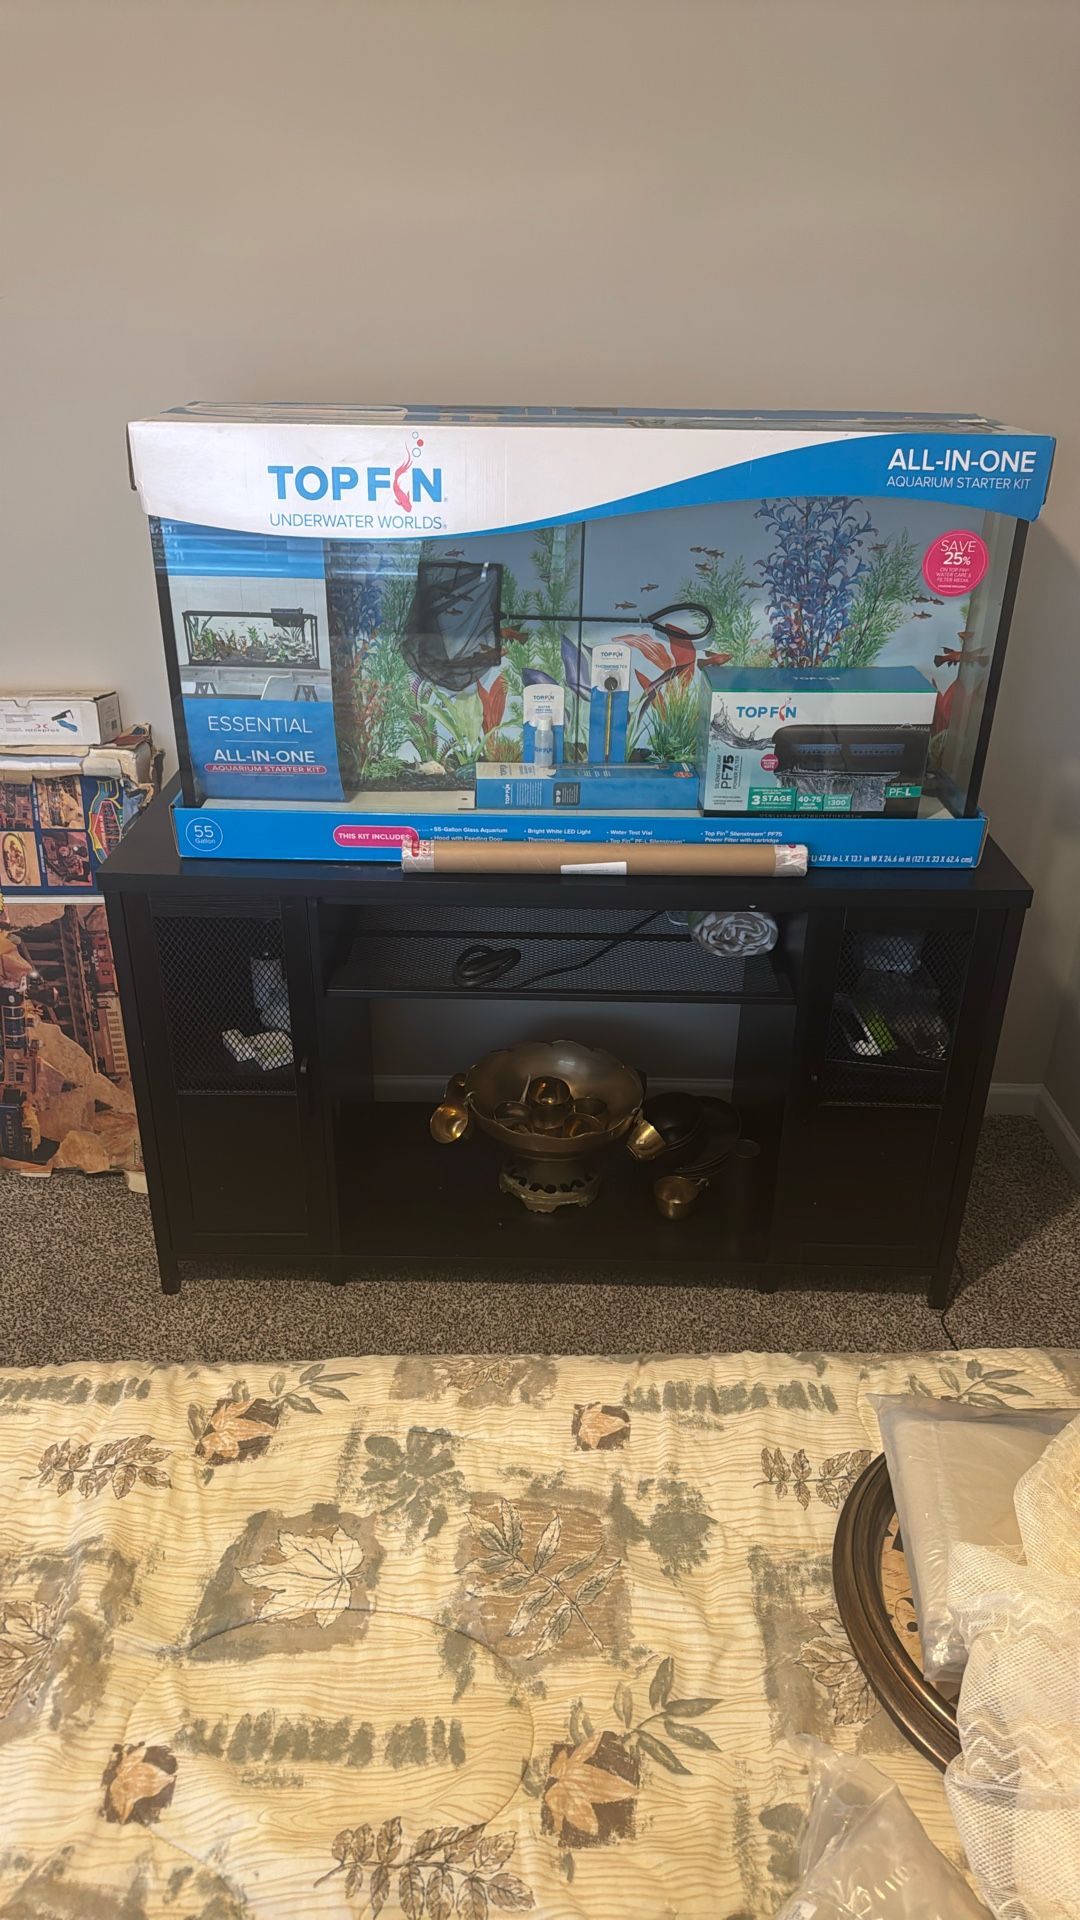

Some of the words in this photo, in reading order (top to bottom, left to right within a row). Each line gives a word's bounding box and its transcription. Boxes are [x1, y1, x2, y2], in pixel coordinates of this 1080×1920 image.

[887, 448, 1037, 473] ALL-IN-ONE
[267, 465, 359, 501] TOP
[886, 475, 953, 488] AQUARIUM
[956, 477, 1010, 489] STARTER
[1013, 478, 1032, 490] KIT
[269, 513, 374, 528] UNDERWATER
[378, 514, 443, 530] WORLDS
[940, 539, 977, 553] SAVE
[943, 551, 971, 566] 25%
[736, 706, 768, 718] TOP
[207, 715, 313, 733] ESSENTIAL
[213, 749, 316, 763] ALL-IN-ONE
[720, 754, 735, 790] PF75
[798, 795, 822, 803] 40-75
[889, 787, 912, 797] PF-L
[751, 795, 761, 806] 3
[194, 825, 214, 838] 55
[338, 832, 356, 840] THIS
[878, 855, 884, 863] X
[883, 855, 898, 863] 24.6
